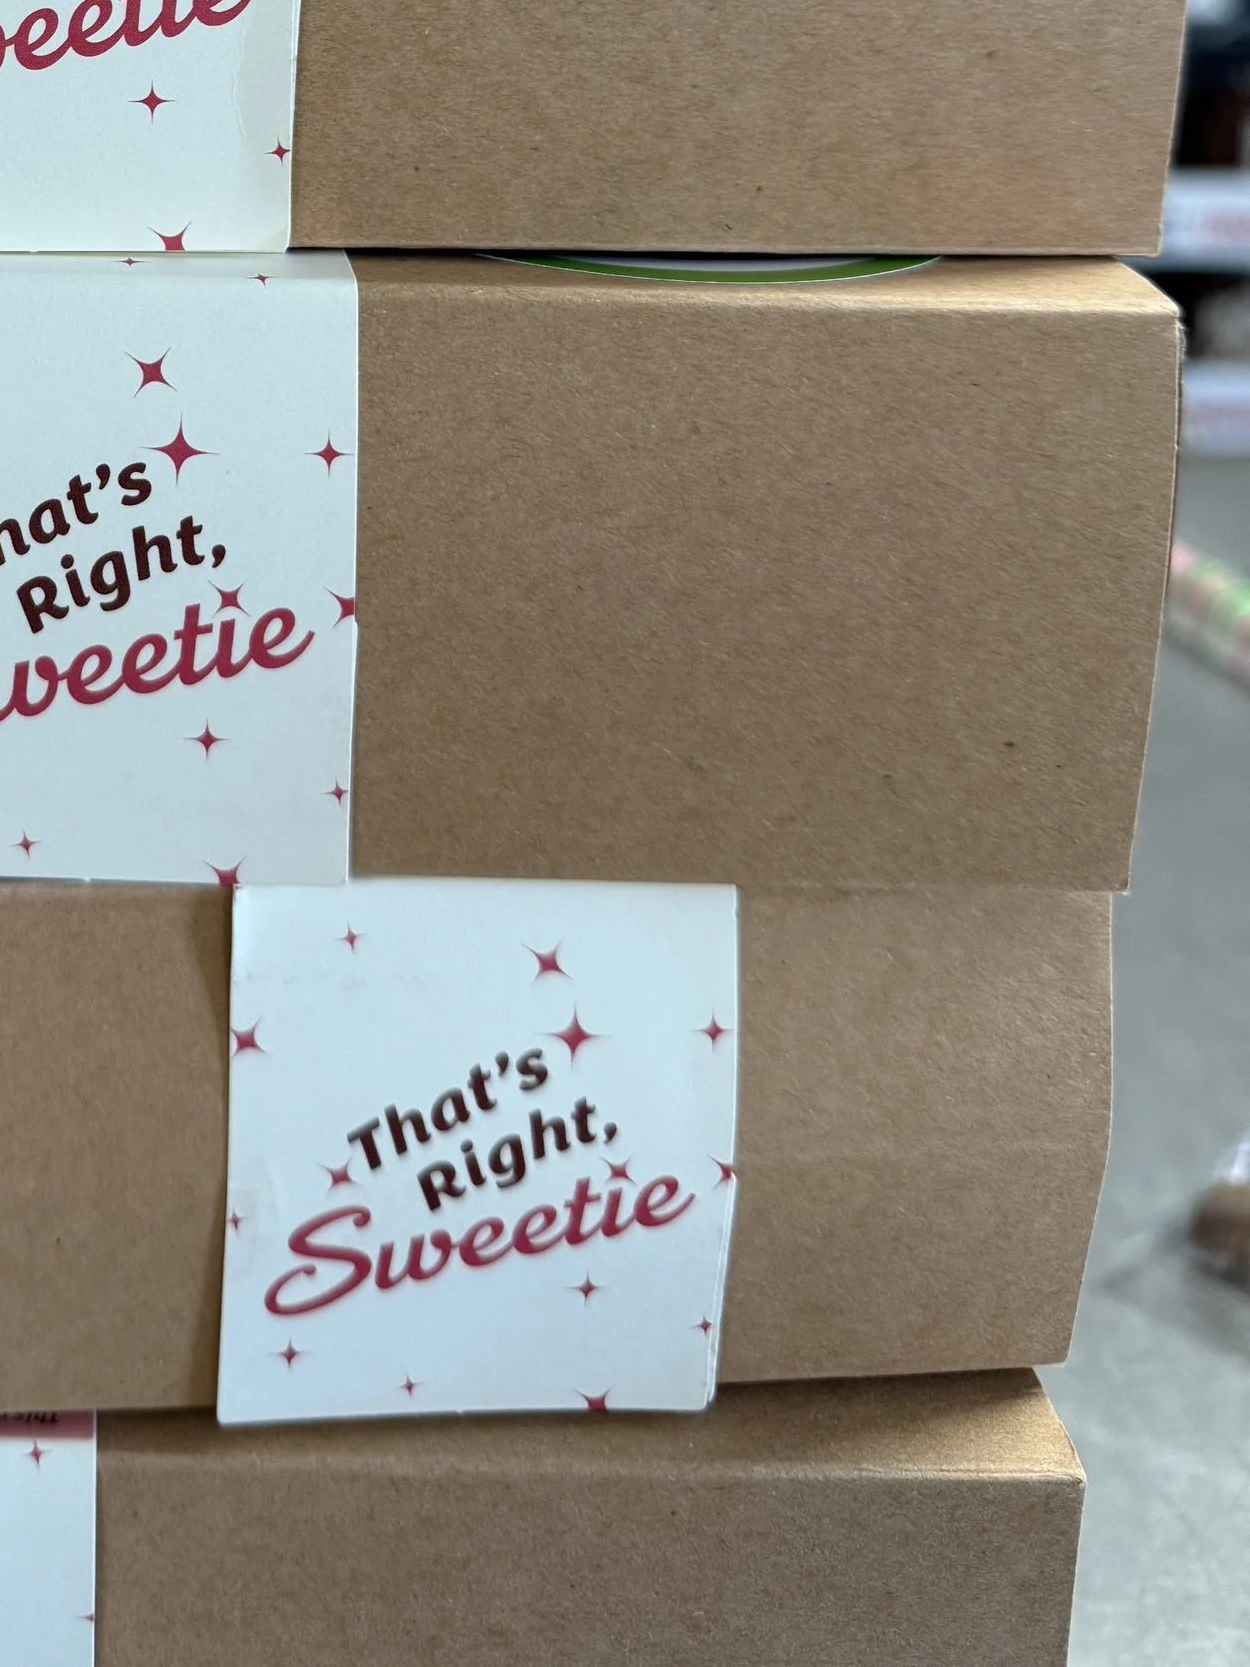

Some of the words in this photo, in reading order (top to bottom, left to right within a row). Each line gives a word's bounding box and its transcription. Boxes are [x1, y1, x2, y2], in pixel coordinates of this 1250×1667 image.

[16, 515, 227, 635] Right,
[347, 1050, 549, 1171] That's
[417, 1099, 619, 1213] Right,
[264, 1177, 695, 1317] Sweetie
